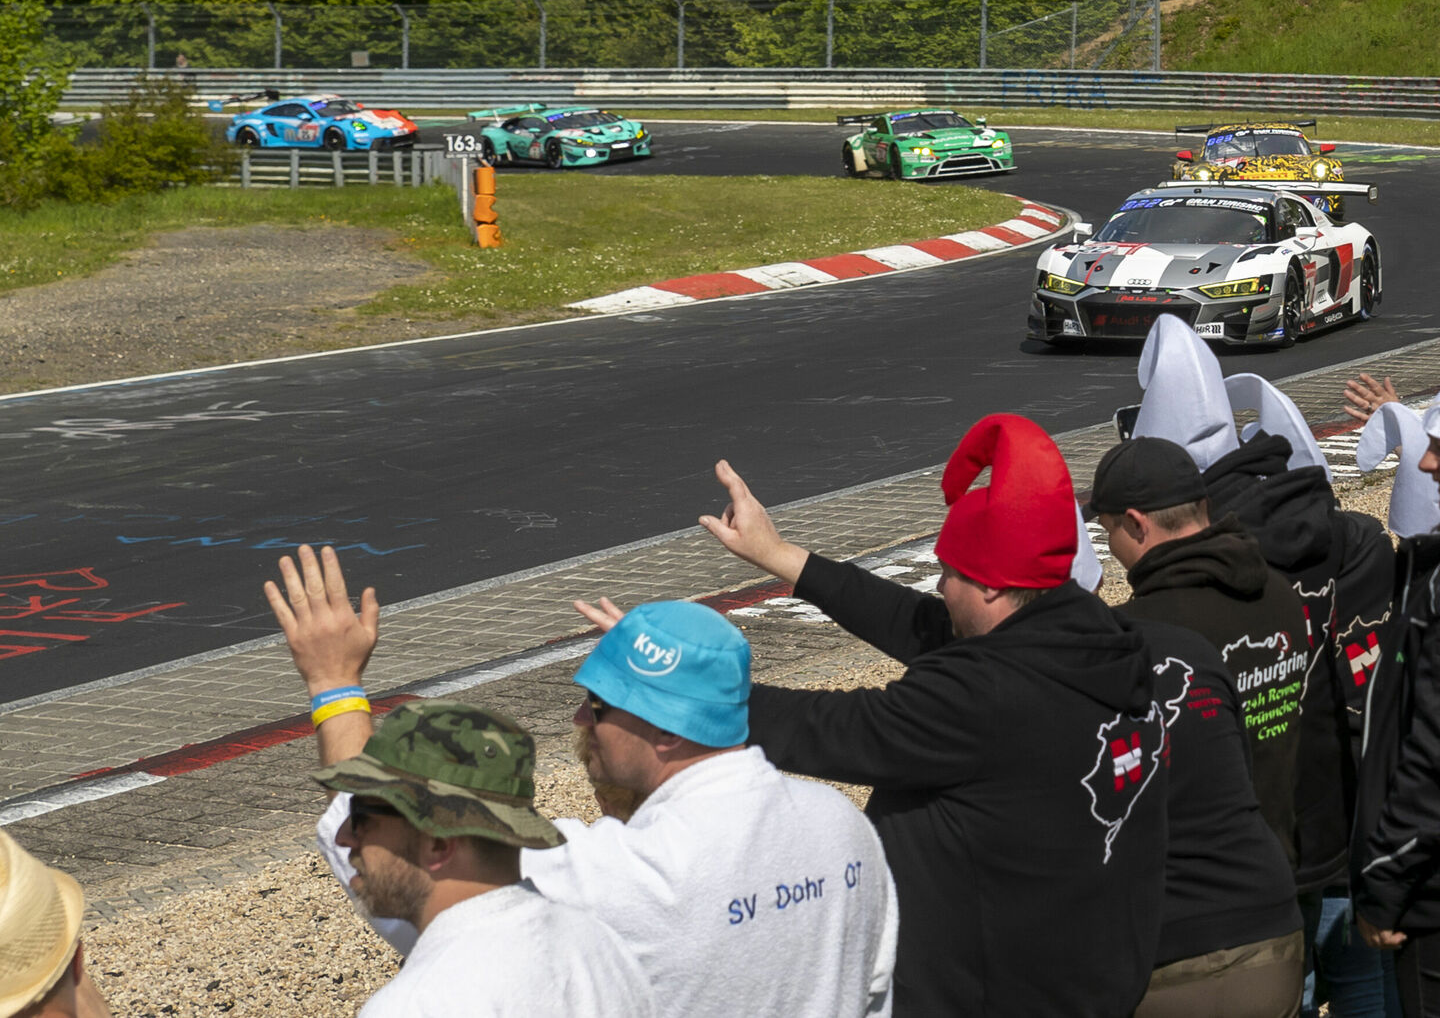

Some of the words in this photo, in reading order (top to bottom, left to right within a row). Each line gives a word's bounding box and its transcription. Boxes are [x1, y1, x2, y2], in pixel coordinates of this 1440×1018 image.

[1186, 198, 1217, 206] GRAN
[1237, 650, 1308, 693] ürburgring
[728, 893, 757, 925] SV
[776, 876, 826, 910] Dohr
